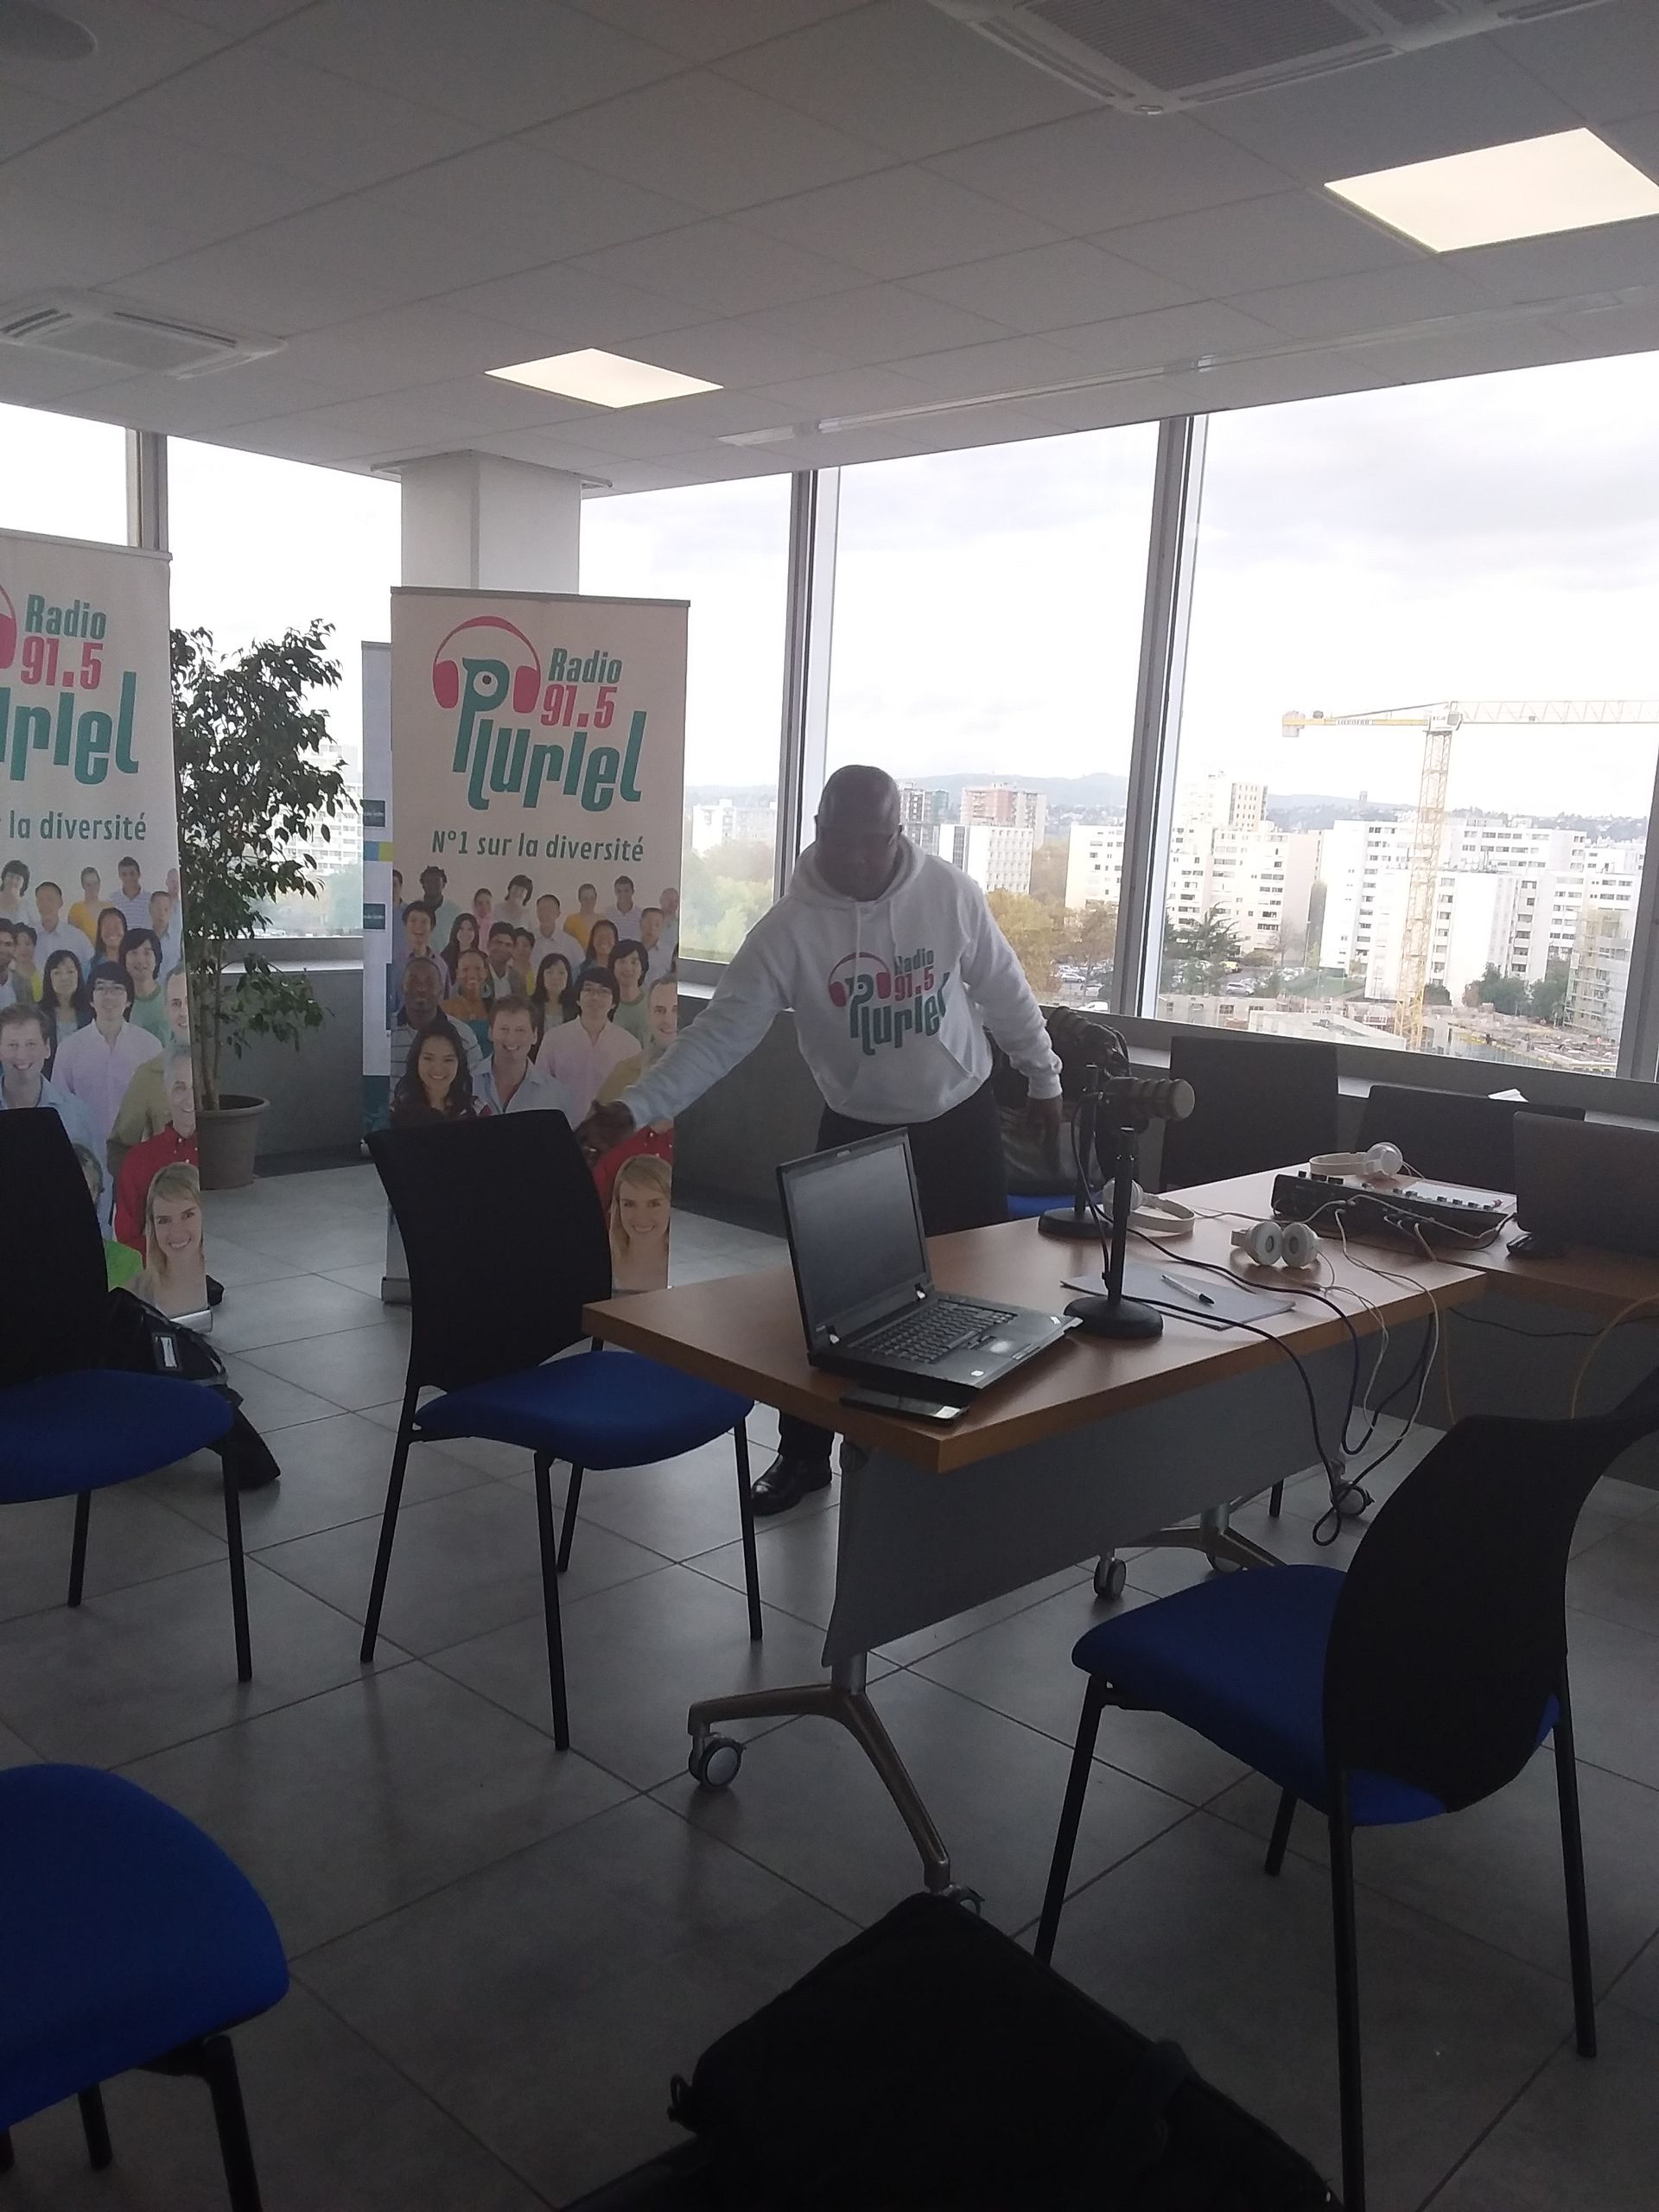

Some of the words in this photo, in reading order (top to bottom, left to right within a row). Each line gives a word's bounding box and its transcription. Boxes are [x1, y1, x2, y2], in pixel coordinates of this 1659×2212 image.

[25, 594, 106, 639] Radio
[20, 636, 103, 690] 91.5
[548, 648, 622, 683] Radio
[0, 671, 139, 785] riel
[540, 683, 618, 728] 91.5
[452, 658, 647, 811] Pluriel
[10, 810, 30, 838] la
[40, 810, 146, 841] diversité
[477, 836, 512, 856] sur
[518, 833, 538, 857] la
[546, 834, 644, 861] diversité
[894, 965, 934, 1001] 91.5
